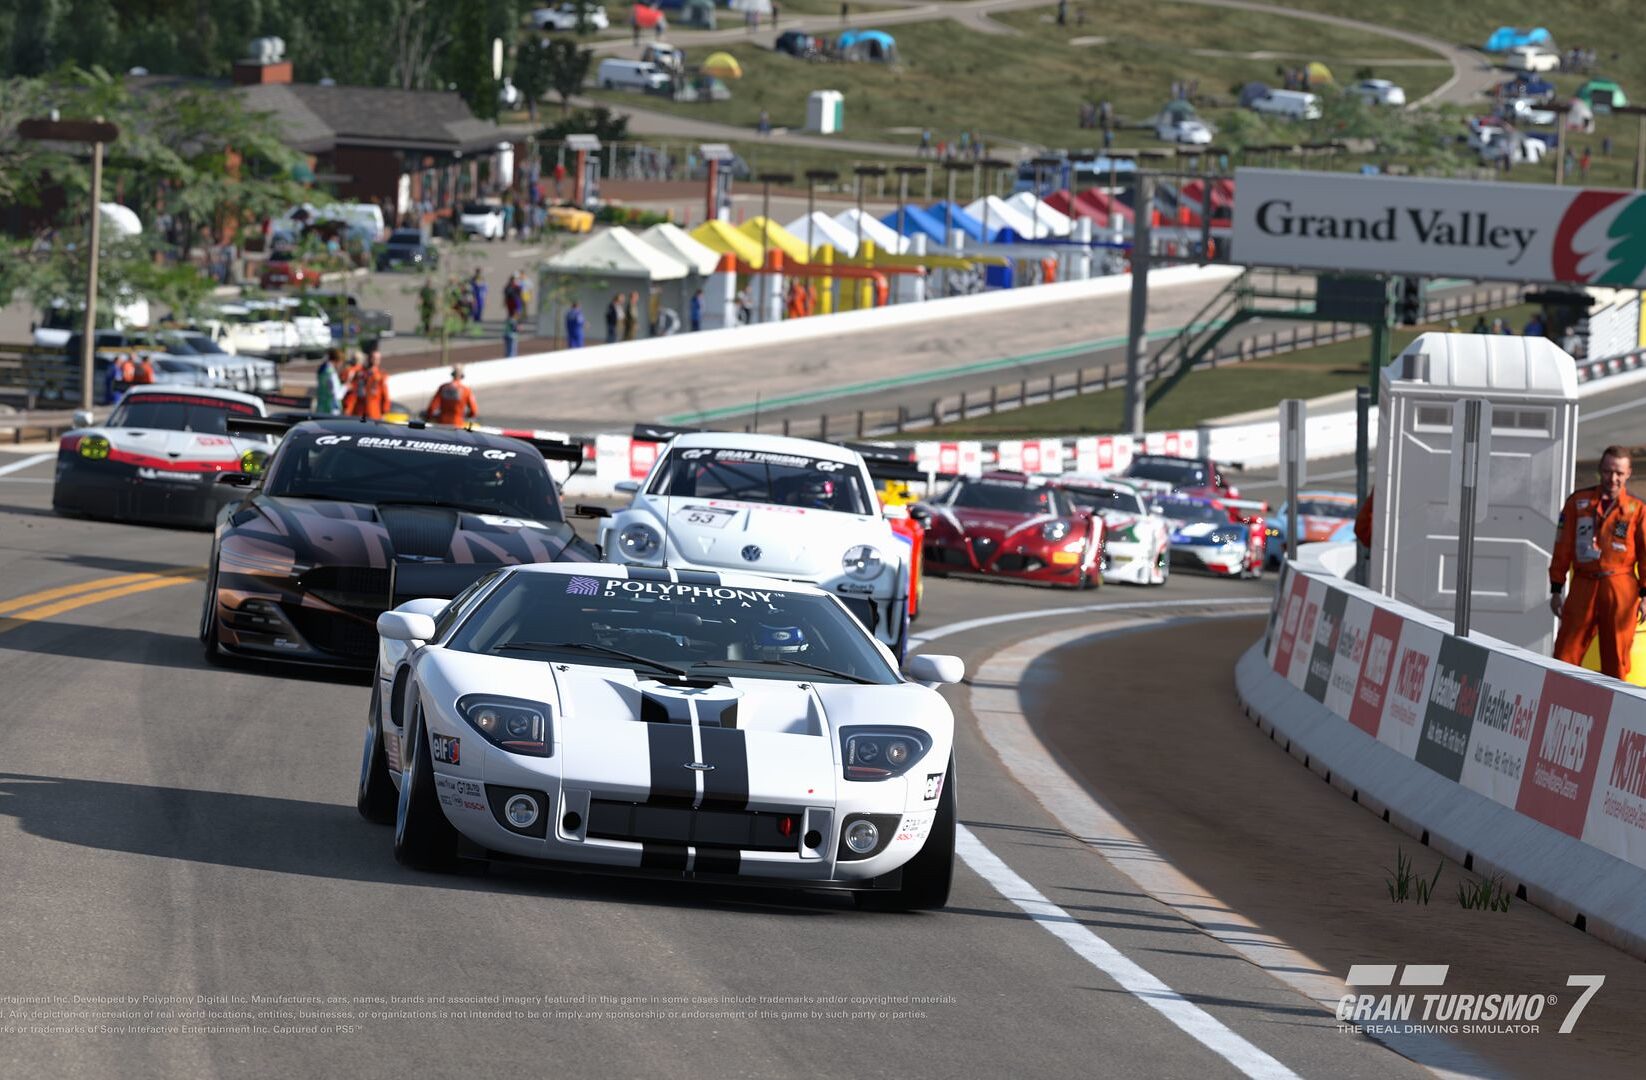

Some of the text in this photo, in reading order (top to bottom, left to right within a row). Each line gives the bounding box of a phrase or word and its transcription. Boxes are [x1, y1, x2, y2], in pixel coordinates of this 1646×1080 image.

[1256, 200, 1538, 266] Grand Valley
[357, 436, 402, 447] GRAN
[715, 450, 751, 460] GRAN
[688, 513, 716, 525] 53
[604, 591, 777, 610] DIGITAL
[1539, 703, 1593, 773] MOTHERS
[433, 737, 448, 760] elf
